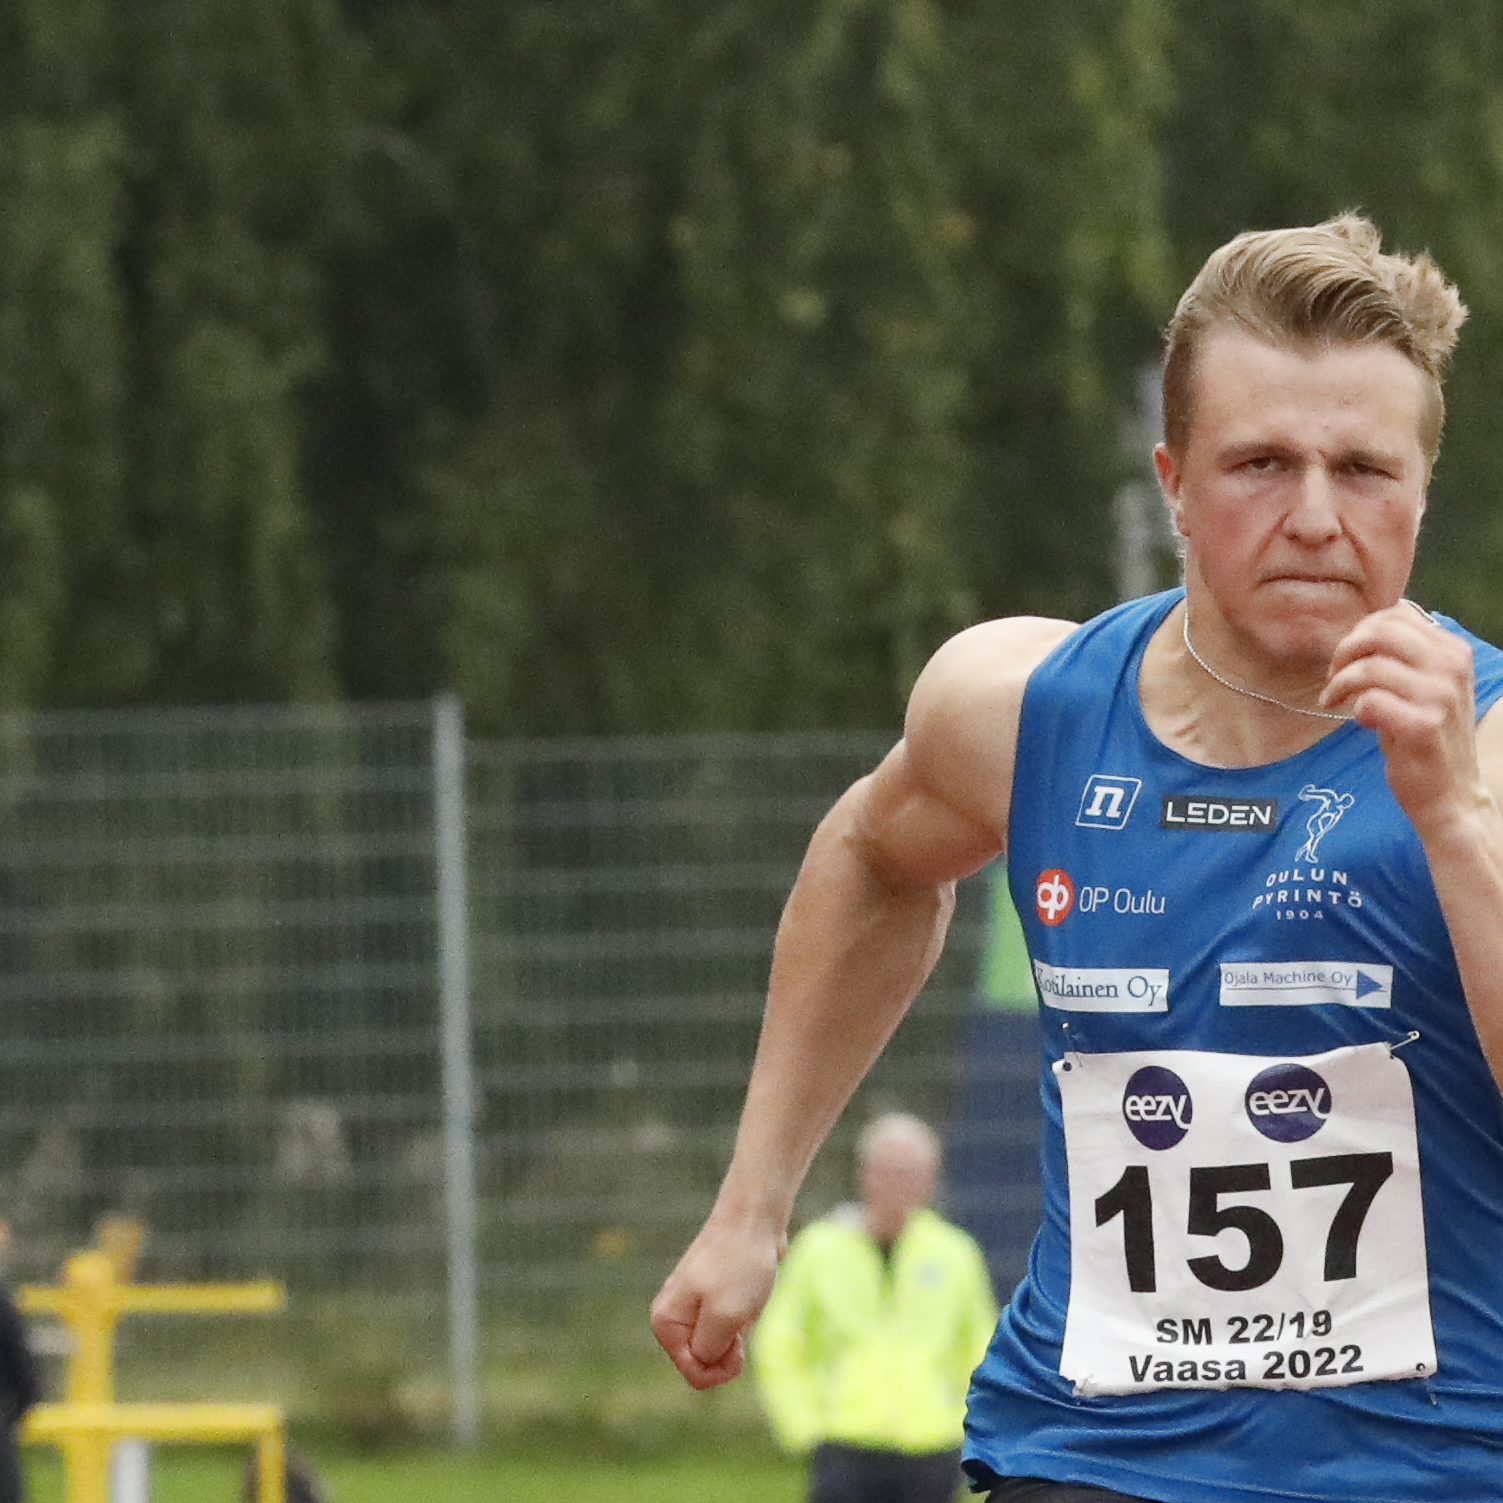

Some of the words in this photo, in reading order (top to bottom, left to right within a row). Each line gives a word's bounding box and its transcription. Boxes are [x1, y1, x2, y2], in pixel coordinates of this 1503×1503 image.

[1164, 799, 1272, 827] LEDEN
[1266, 868, 1349, 888] OULUN
[1079, 887, 1110, 913] OP
[1113, 888, 1167, 915] Oulu
[1252, 888, 1364, 910] PYRINTÖ
[1276, 909, 1325, 921] 1904
[1127, 975, 1163, 1007] Oy
[1224, 970, 1259, 987] Ojala
[1263, 969, 1327, 985] Machine
[1331, 970, 1353, 987] Oy
[1125, 1094, 1192, 1131] eezy
[1249, 1087, 1333, 1119] eezy
[1094, 1151, 1394, 1293] 157
[1156, 1317, 1214, 1346] SM
[1227, 1310, 1334, 1345] 22/19
[1129, 1354, 1247, 1383] Vaasa
[1262, 1344, 1365, 1380] 2022
